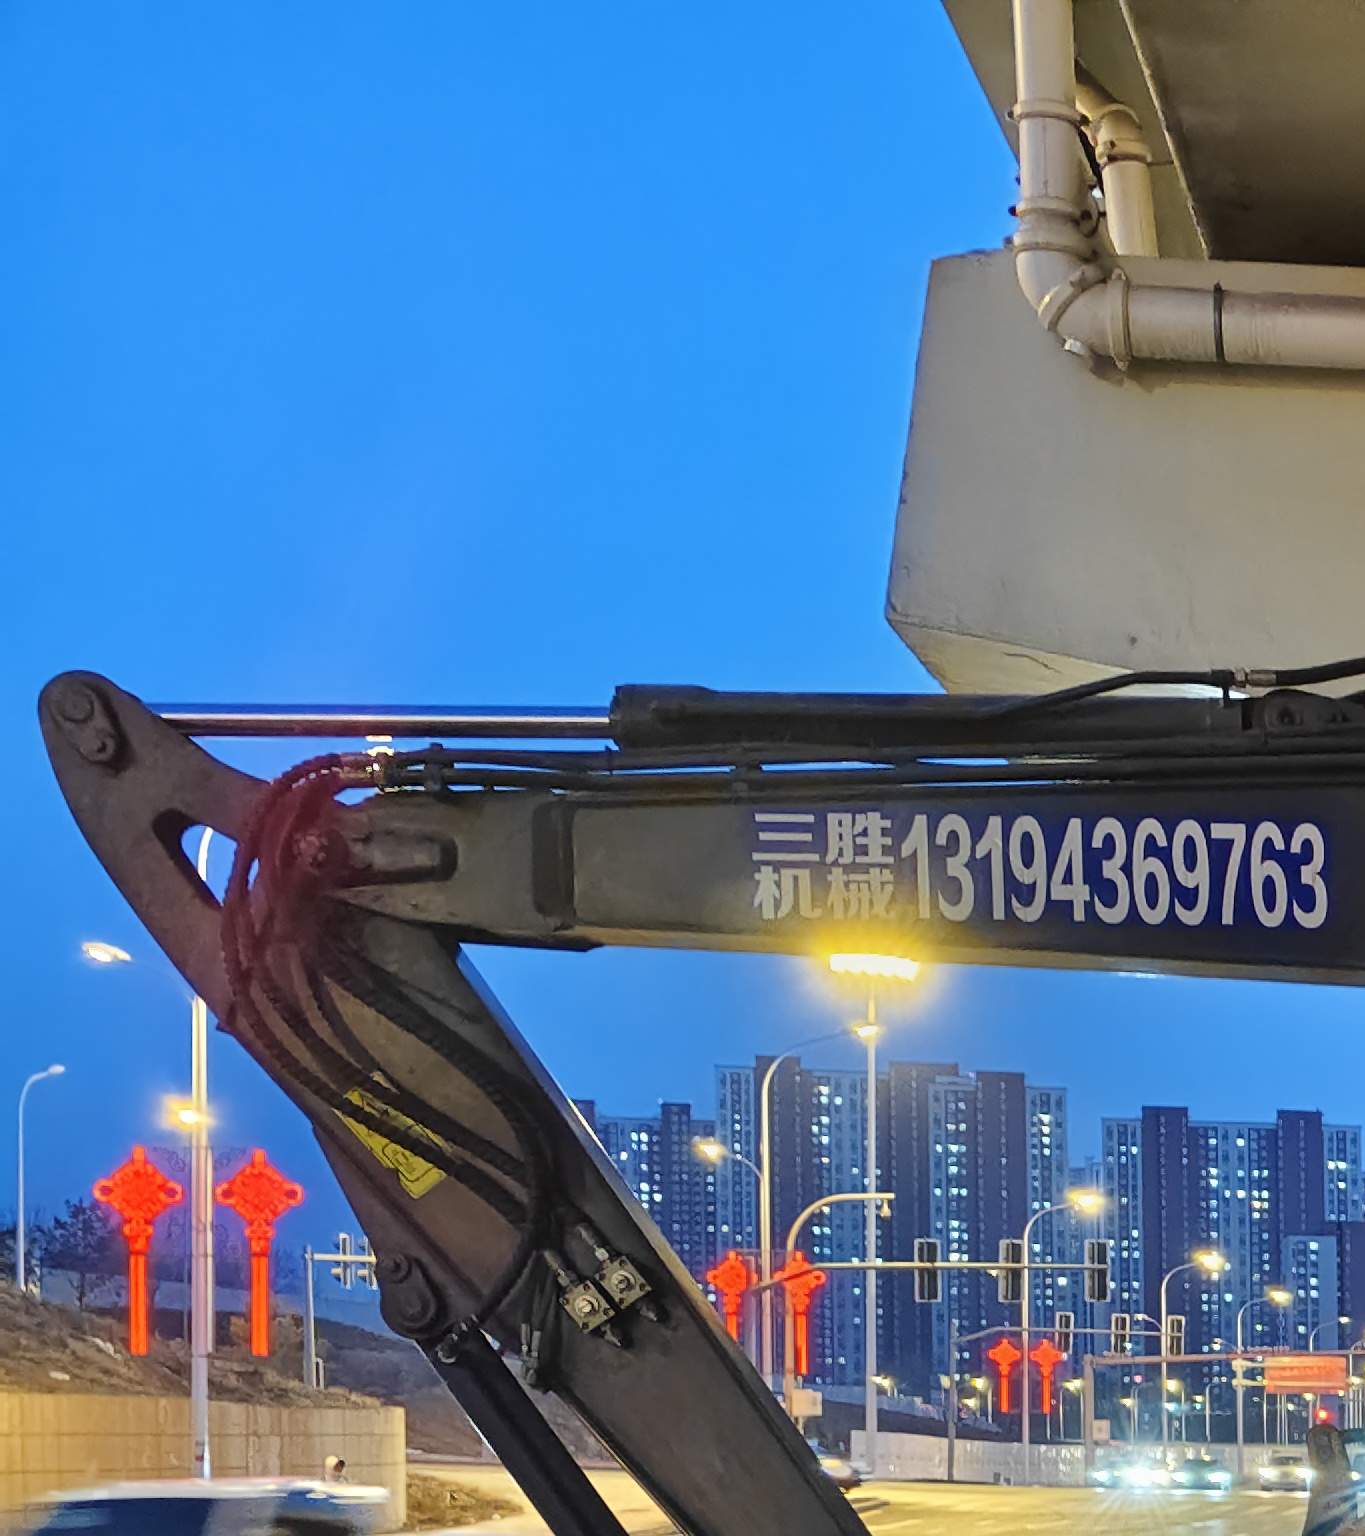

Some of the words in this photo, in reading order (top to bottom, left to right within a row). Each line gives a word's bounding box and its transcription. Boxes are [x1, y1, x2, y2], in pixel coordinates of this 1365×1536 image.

[752, 811, 895, 865] 三胜
[752, 865, 896, 921] 机械
[901, 813, 1328, 929] 13194369763
